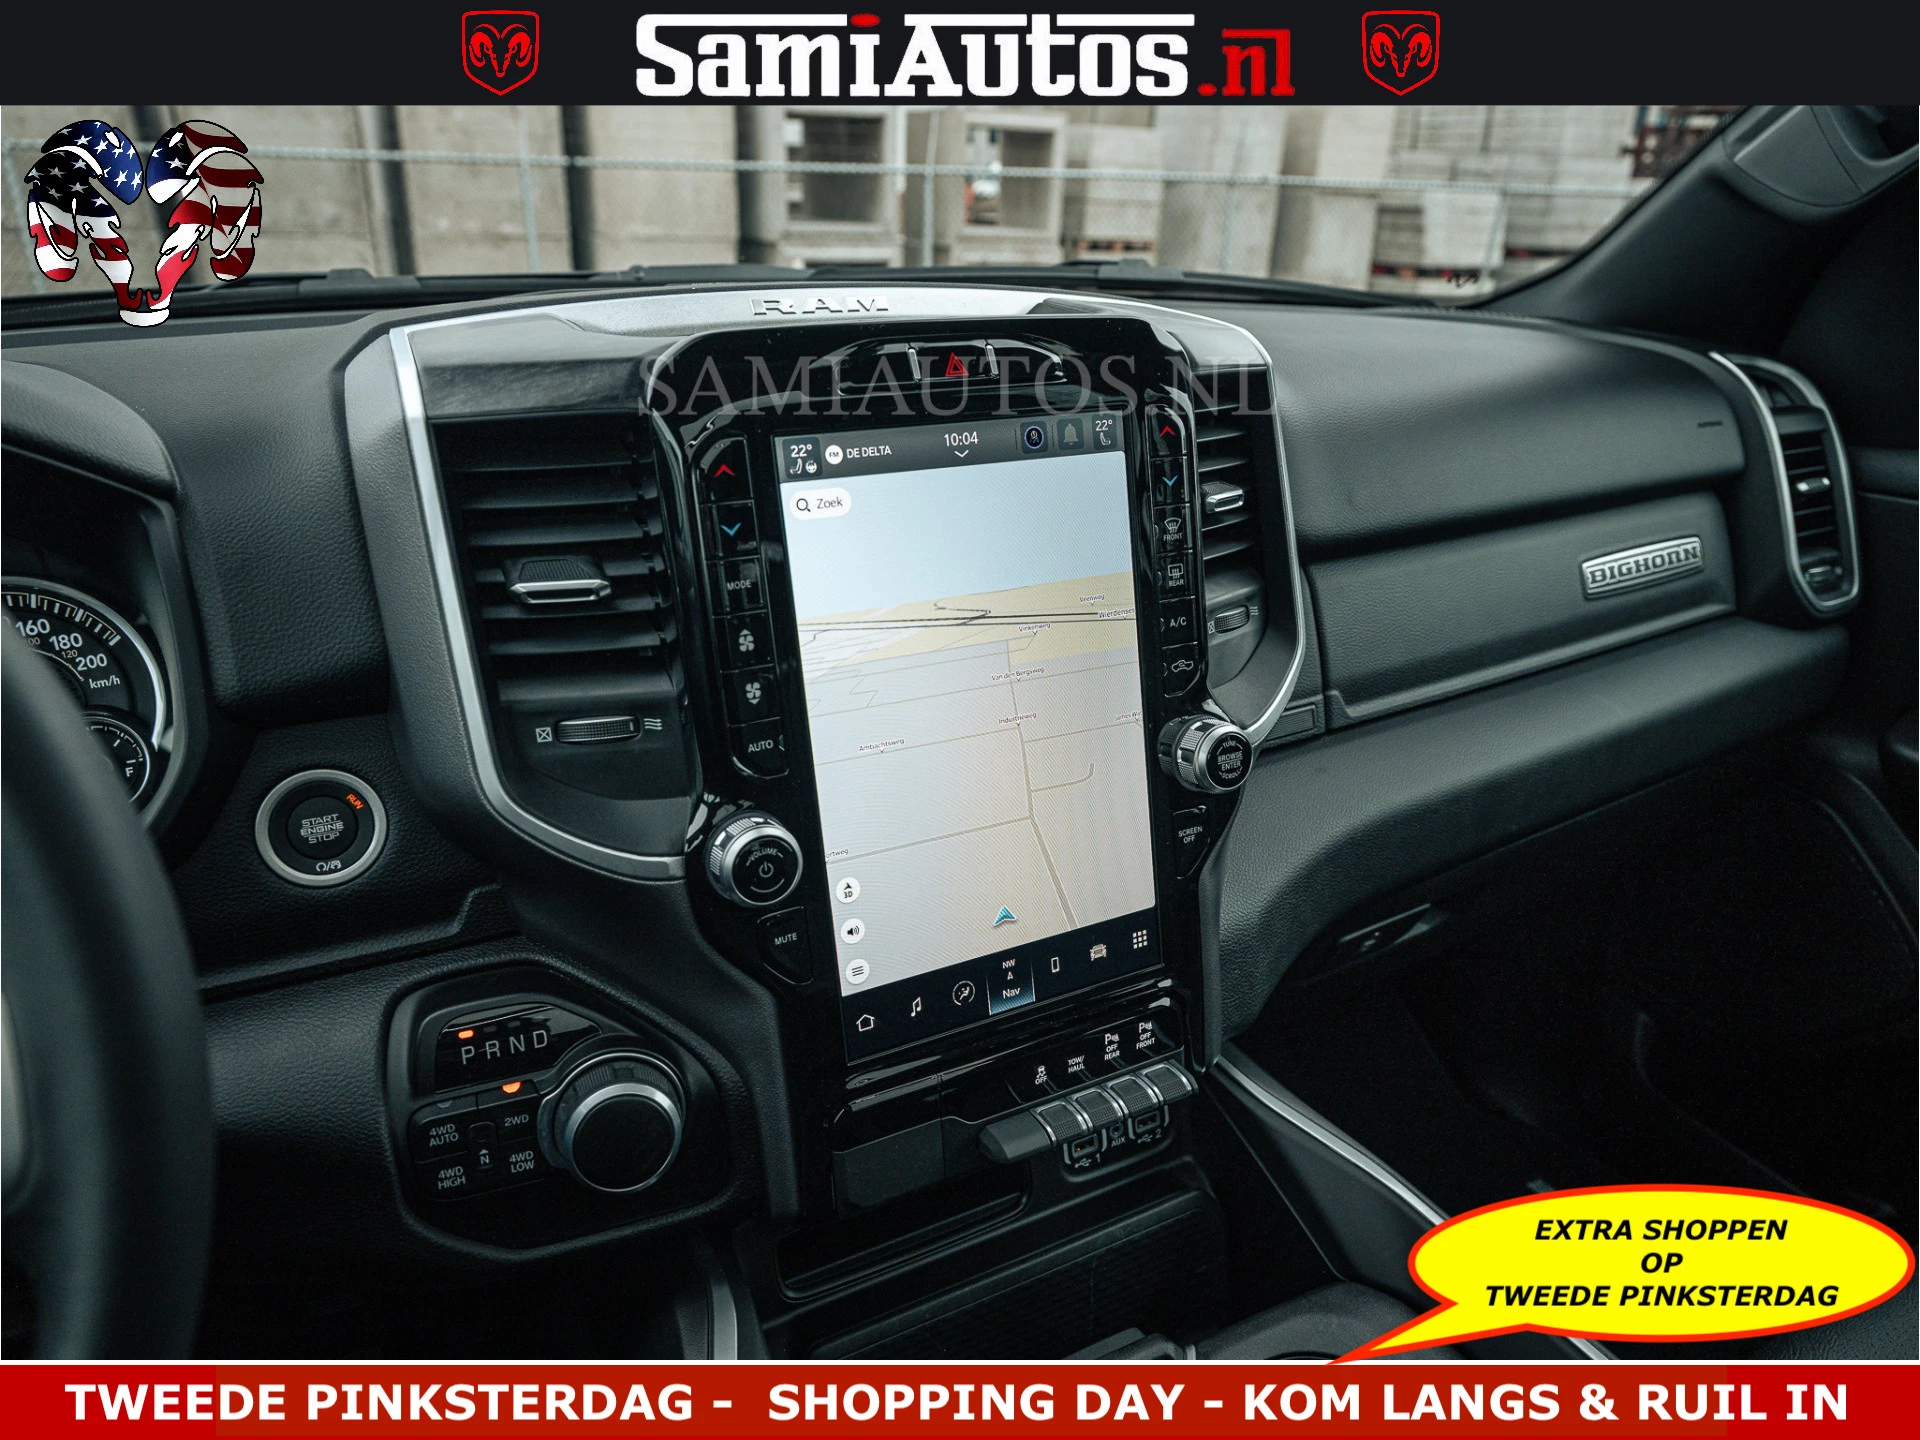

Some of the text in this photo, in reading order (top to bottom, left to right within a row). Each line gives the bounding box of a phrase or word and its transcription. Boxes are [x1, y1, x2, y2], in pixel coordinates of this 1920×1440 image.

[750, 296, 888, 315] RAM
[944, 430, 979, 447] 10:04
[846, 448, 860, 459] DE
[861, 445, 892, 458] DELTA
[816, 496, 843, 510] Zoek
[1163, 532, 1183, 542] FRONT
[1588, 546, 1700, 585] BIGHORN
[726, 579, 752, 591] MODE
[1168, 579, 1184, 587] REAR
[1099, 607, 1136, 619] Wierdenses
[15, 618, 51, 637] 160
[1169, 616, 1187, 628] A/C
[49, 632, 83, 651] 180
[61, 649, 78, 659] 120
[75, 653, 108, 671] 200
[89, 675, 121, 689] km/h
[747, 739, 774, 753] AUTO
[859, 738, 905, 752] Ambachtsweg
[1217, 750, 1243, 762] BROWSE
[1221, 760, 1242, 771] ENTER
[125, 767, 134, 778] F
[346, 793, 365, 810] RUN
[301, 813, 340, 827] START
[300, 821, 345, 837] ENGINE
[1178, 825, 1203, 838] SCREEN
[308, 832, 340, 844] STOP
[1183, 834, 1196, 845] OFF
[749, 848, 778, 862] VOLUME
[843, 890, 853, 899] 3D
[774, 932, 798, 946] MUTE
[1002, 958, 1016, 970] NW
[1002, 986, 1021, 999] Nav
[1139, 1031, 1152, 1041] OFF
[1106, 1043, 1118, 1053] OFF
[1136, 1037, 1156, 1050] FRONT
[1104, 1050, 1120, 1061] REAR
[1068, 1063, 1086, 1073] HAUL
[1035, 1075, 1048, 1085] OFF
[504, 1113, 530, 1128] 2WD
[429, 1123, 456, 1137] 4WD
[1155, 1129, 1162, 1139] 2
[429, 1132, 459, 1147] AUTO
[1111, 1136, 1127, 1147] AUX
[480, 1154, 490, 1165] N
[509, 1150, 534, 1163] 4WD
[510, 1159, 535, 1173] LOW
[437, 1166, 464, 1180] 4WD
[438, 1175, 466, 1190] HIGH
